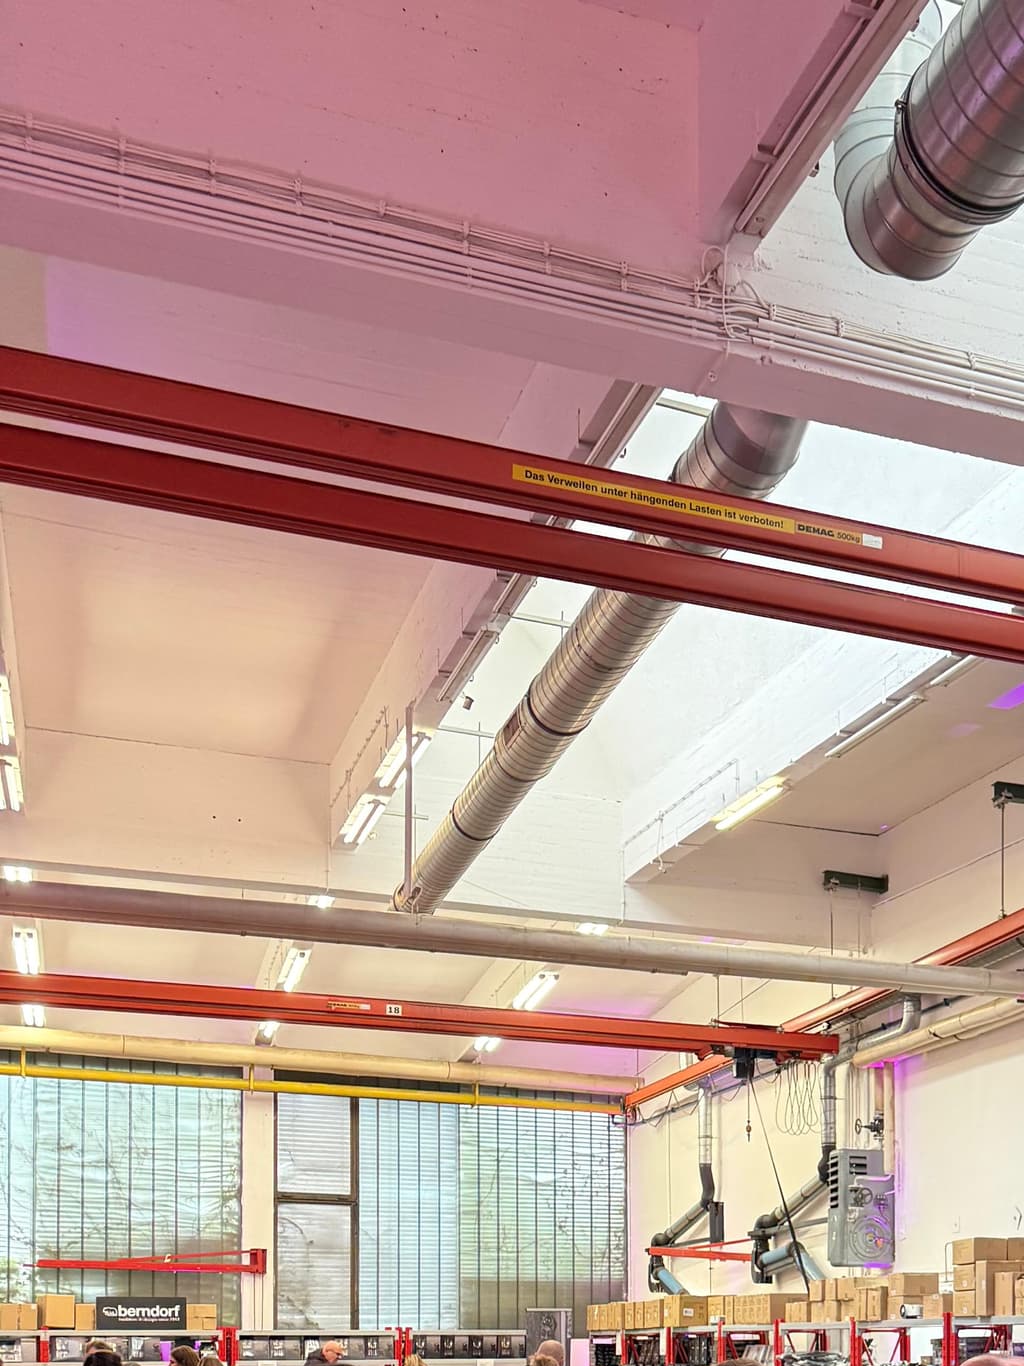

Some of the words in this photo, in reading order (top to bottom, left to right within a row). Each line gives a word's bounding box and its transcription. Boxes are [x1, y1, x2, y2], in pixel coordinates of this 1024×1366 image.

[525, 470, 544, 481] Das
[548, 474, 598, 491] Verweilen
[601, 487, 628, 498] unter
[630, 491, 687, 509] hängenden
[689, 503, 722, 516] Lasten
[724, 508, 736, 519] ist
[739, 514, 784, 529] verboten!
[797, 524, 834, 537] DEMAG
[837, 532, 861, 544] 500kg
[388, 1006, 400, 1014] 18
[118, 1305, 180, 1317] berndorf
